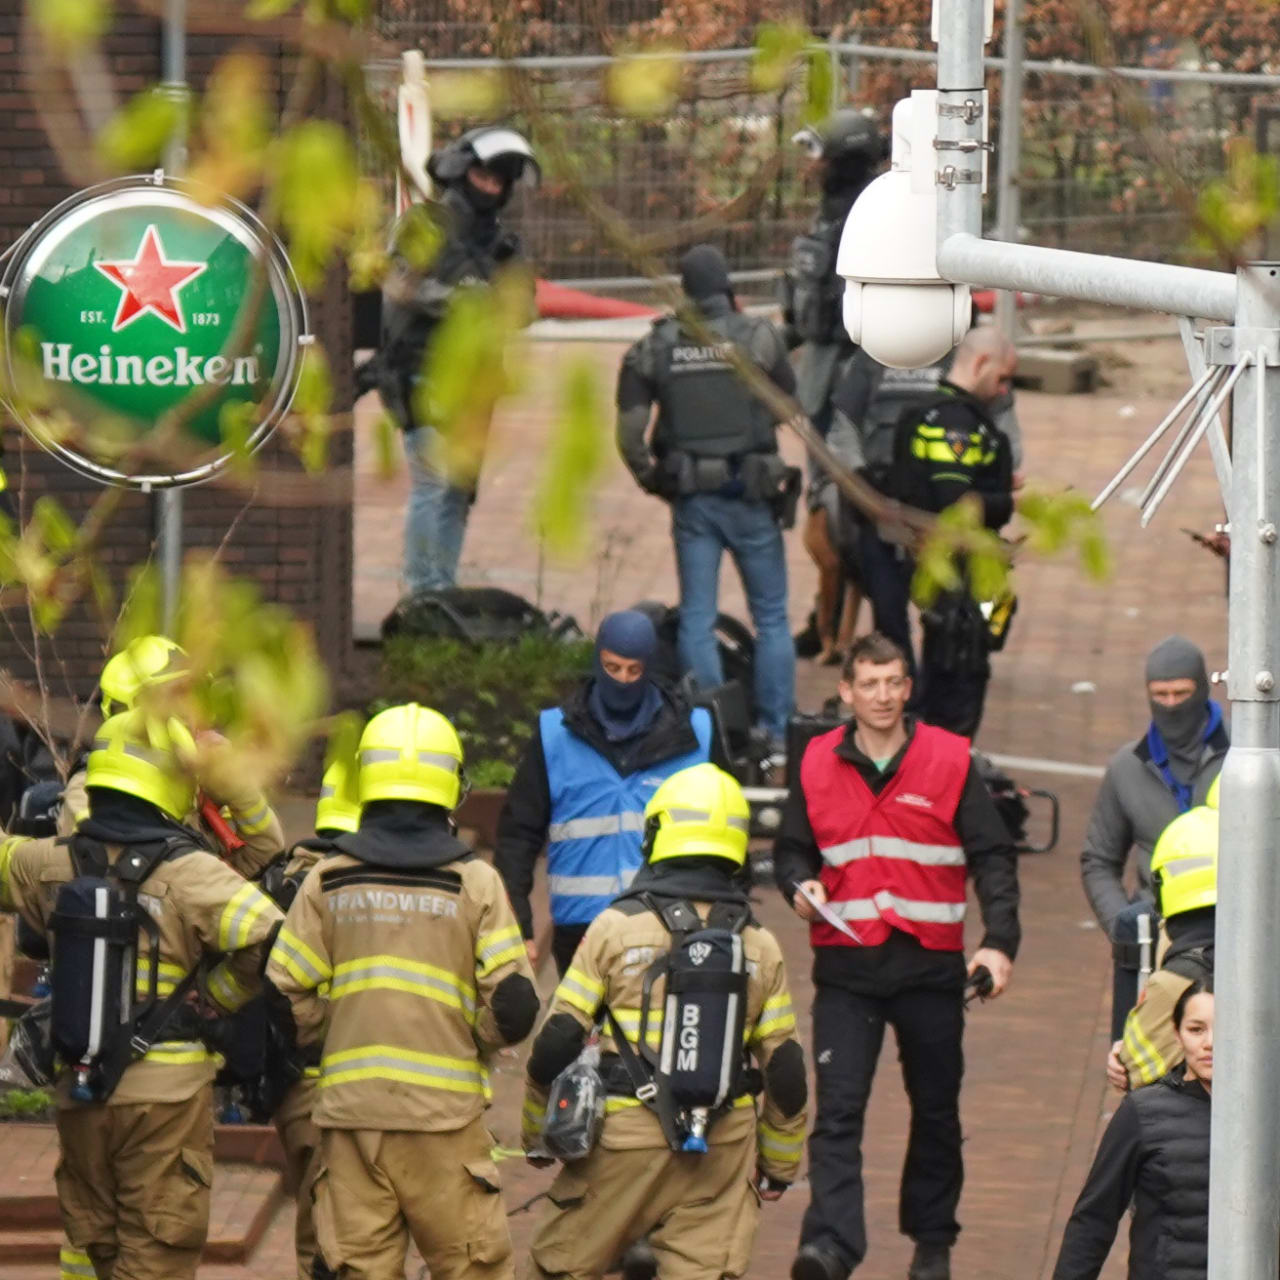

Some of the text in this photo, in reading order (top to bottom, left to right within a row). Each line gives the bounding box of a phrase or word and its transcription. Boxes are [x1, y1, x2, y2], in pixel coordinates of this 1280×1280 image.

[80, 311, 220, 326] EST. 1873
[41, 342, 259, 386] Heineken
[677, 1004, 700, 1071] BGM
